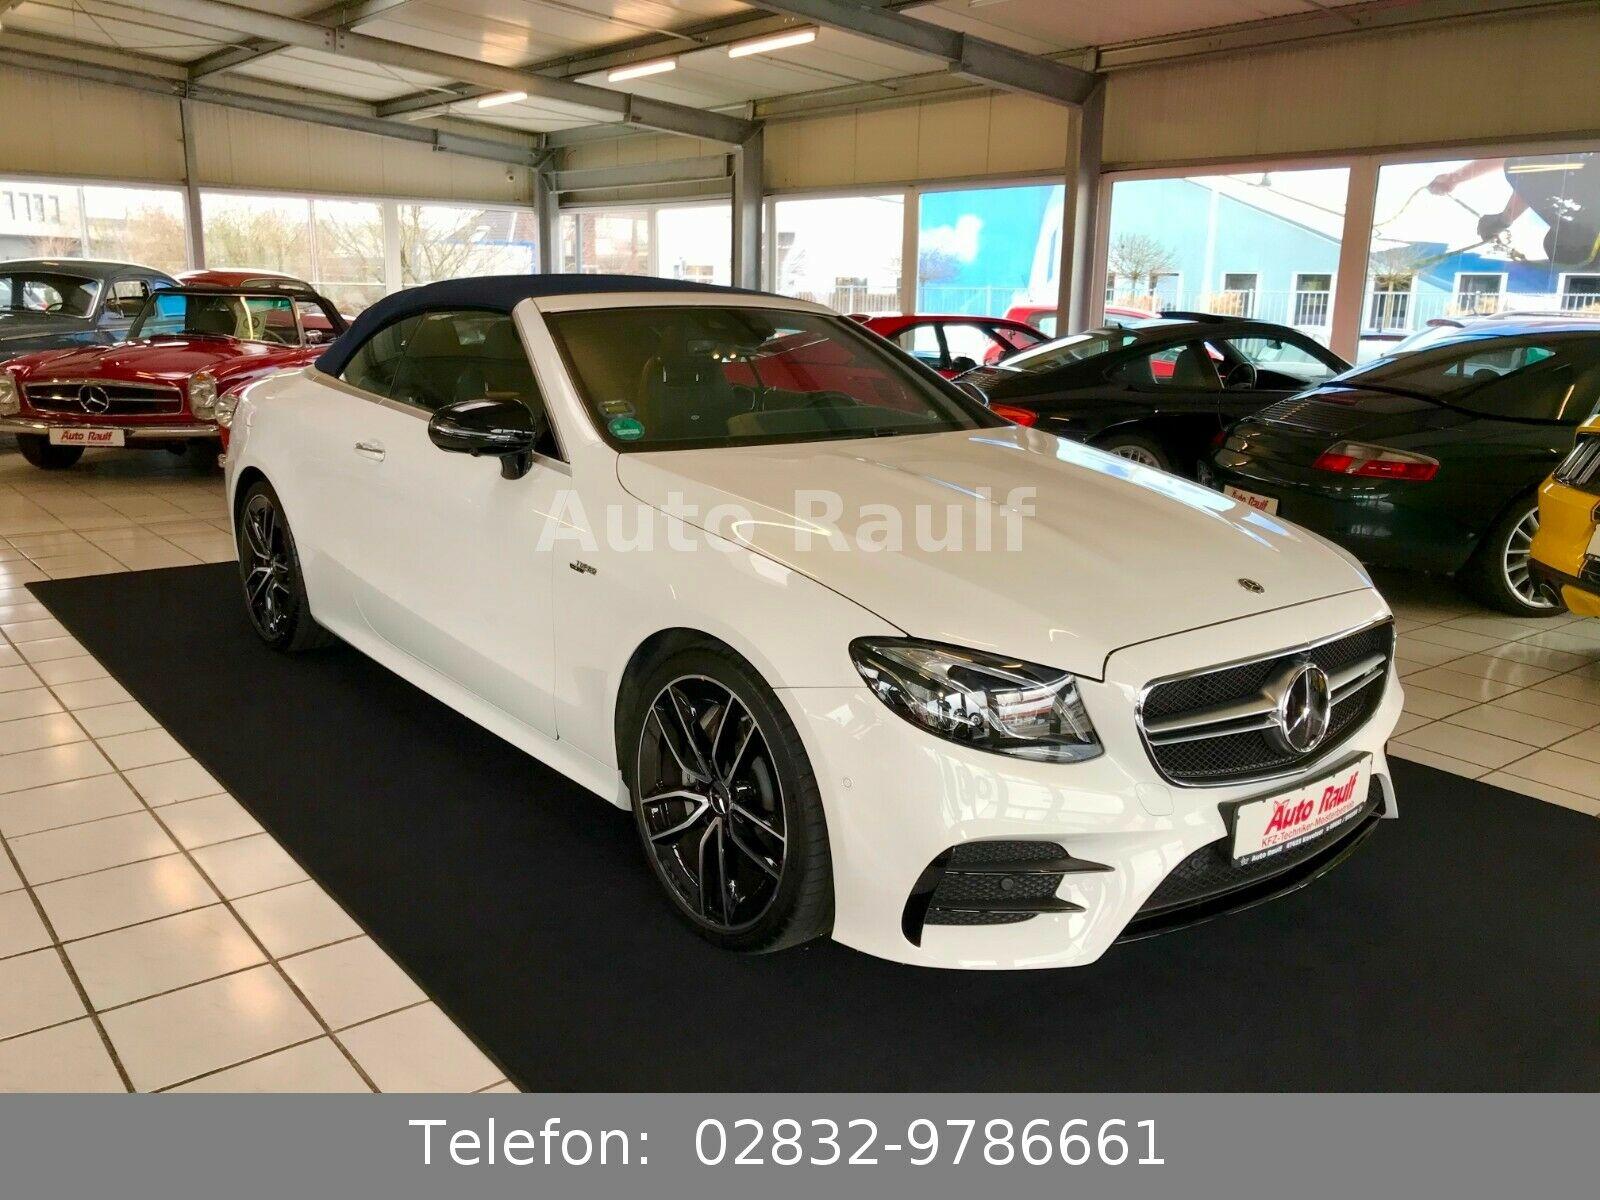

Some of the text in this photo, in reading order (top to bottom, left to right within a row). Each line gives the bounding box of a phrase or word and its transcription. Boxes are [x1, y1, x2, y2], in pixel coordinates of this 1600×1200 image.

[61, 430, 113, 441] Auto Raulf
[1263, 798, 1315, 836] Auto
[1317, 770, 1359, 815] Raulf
